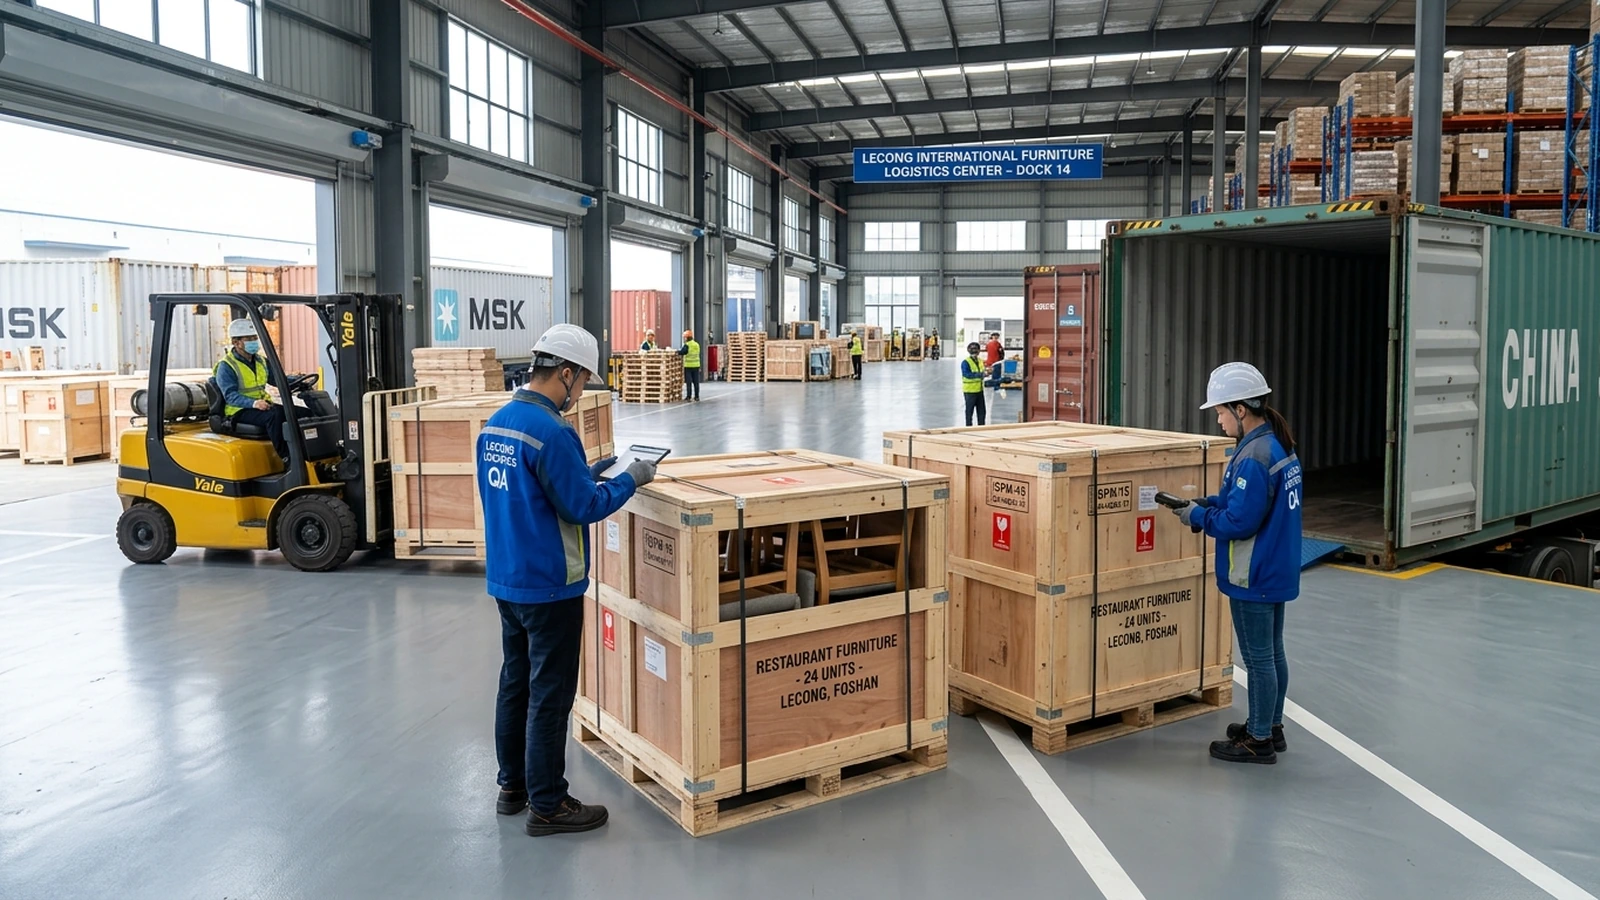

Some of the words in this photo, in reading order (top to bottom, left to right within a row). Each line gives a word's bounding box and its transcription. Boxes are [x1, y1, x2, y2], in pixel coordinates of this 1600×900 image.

[862, 152, 914, 164] LECONG
[916, 150, 1019, 163] INTERNATIONAL
[1021, 149, 1095, 162] FURNITURE
[884, 165, 950, 178] LOGISTICS
[952, 164, 1003, 177] CENTER
[1016, 164, 1053, 176] DOCK
[1056, 164, 1071, 175] 14
[469, 297, 526, 330] MSK
[340, 311, 355, 348] Yale
[1502, 328, 1580, 409] CHINA
[194, 477, 225, 493] Yale
[488, 466, 509, 491] QA
[1147, 589, 1191, 608] FURNITURE
[1137, 611, 1161, 626] UNITS
[1145, 624, 1178, 641] FOSHAN
[756, 646, 833, 674] RESTAURANT
[836, 634, 898, 658] FURNITURE
[803, 670, 819, 684] 24
[821, 661, 856, 681] UNITS
[780, 686, 831, 709] LECONG,
[834, 675, 879, 697] FOSHAN
